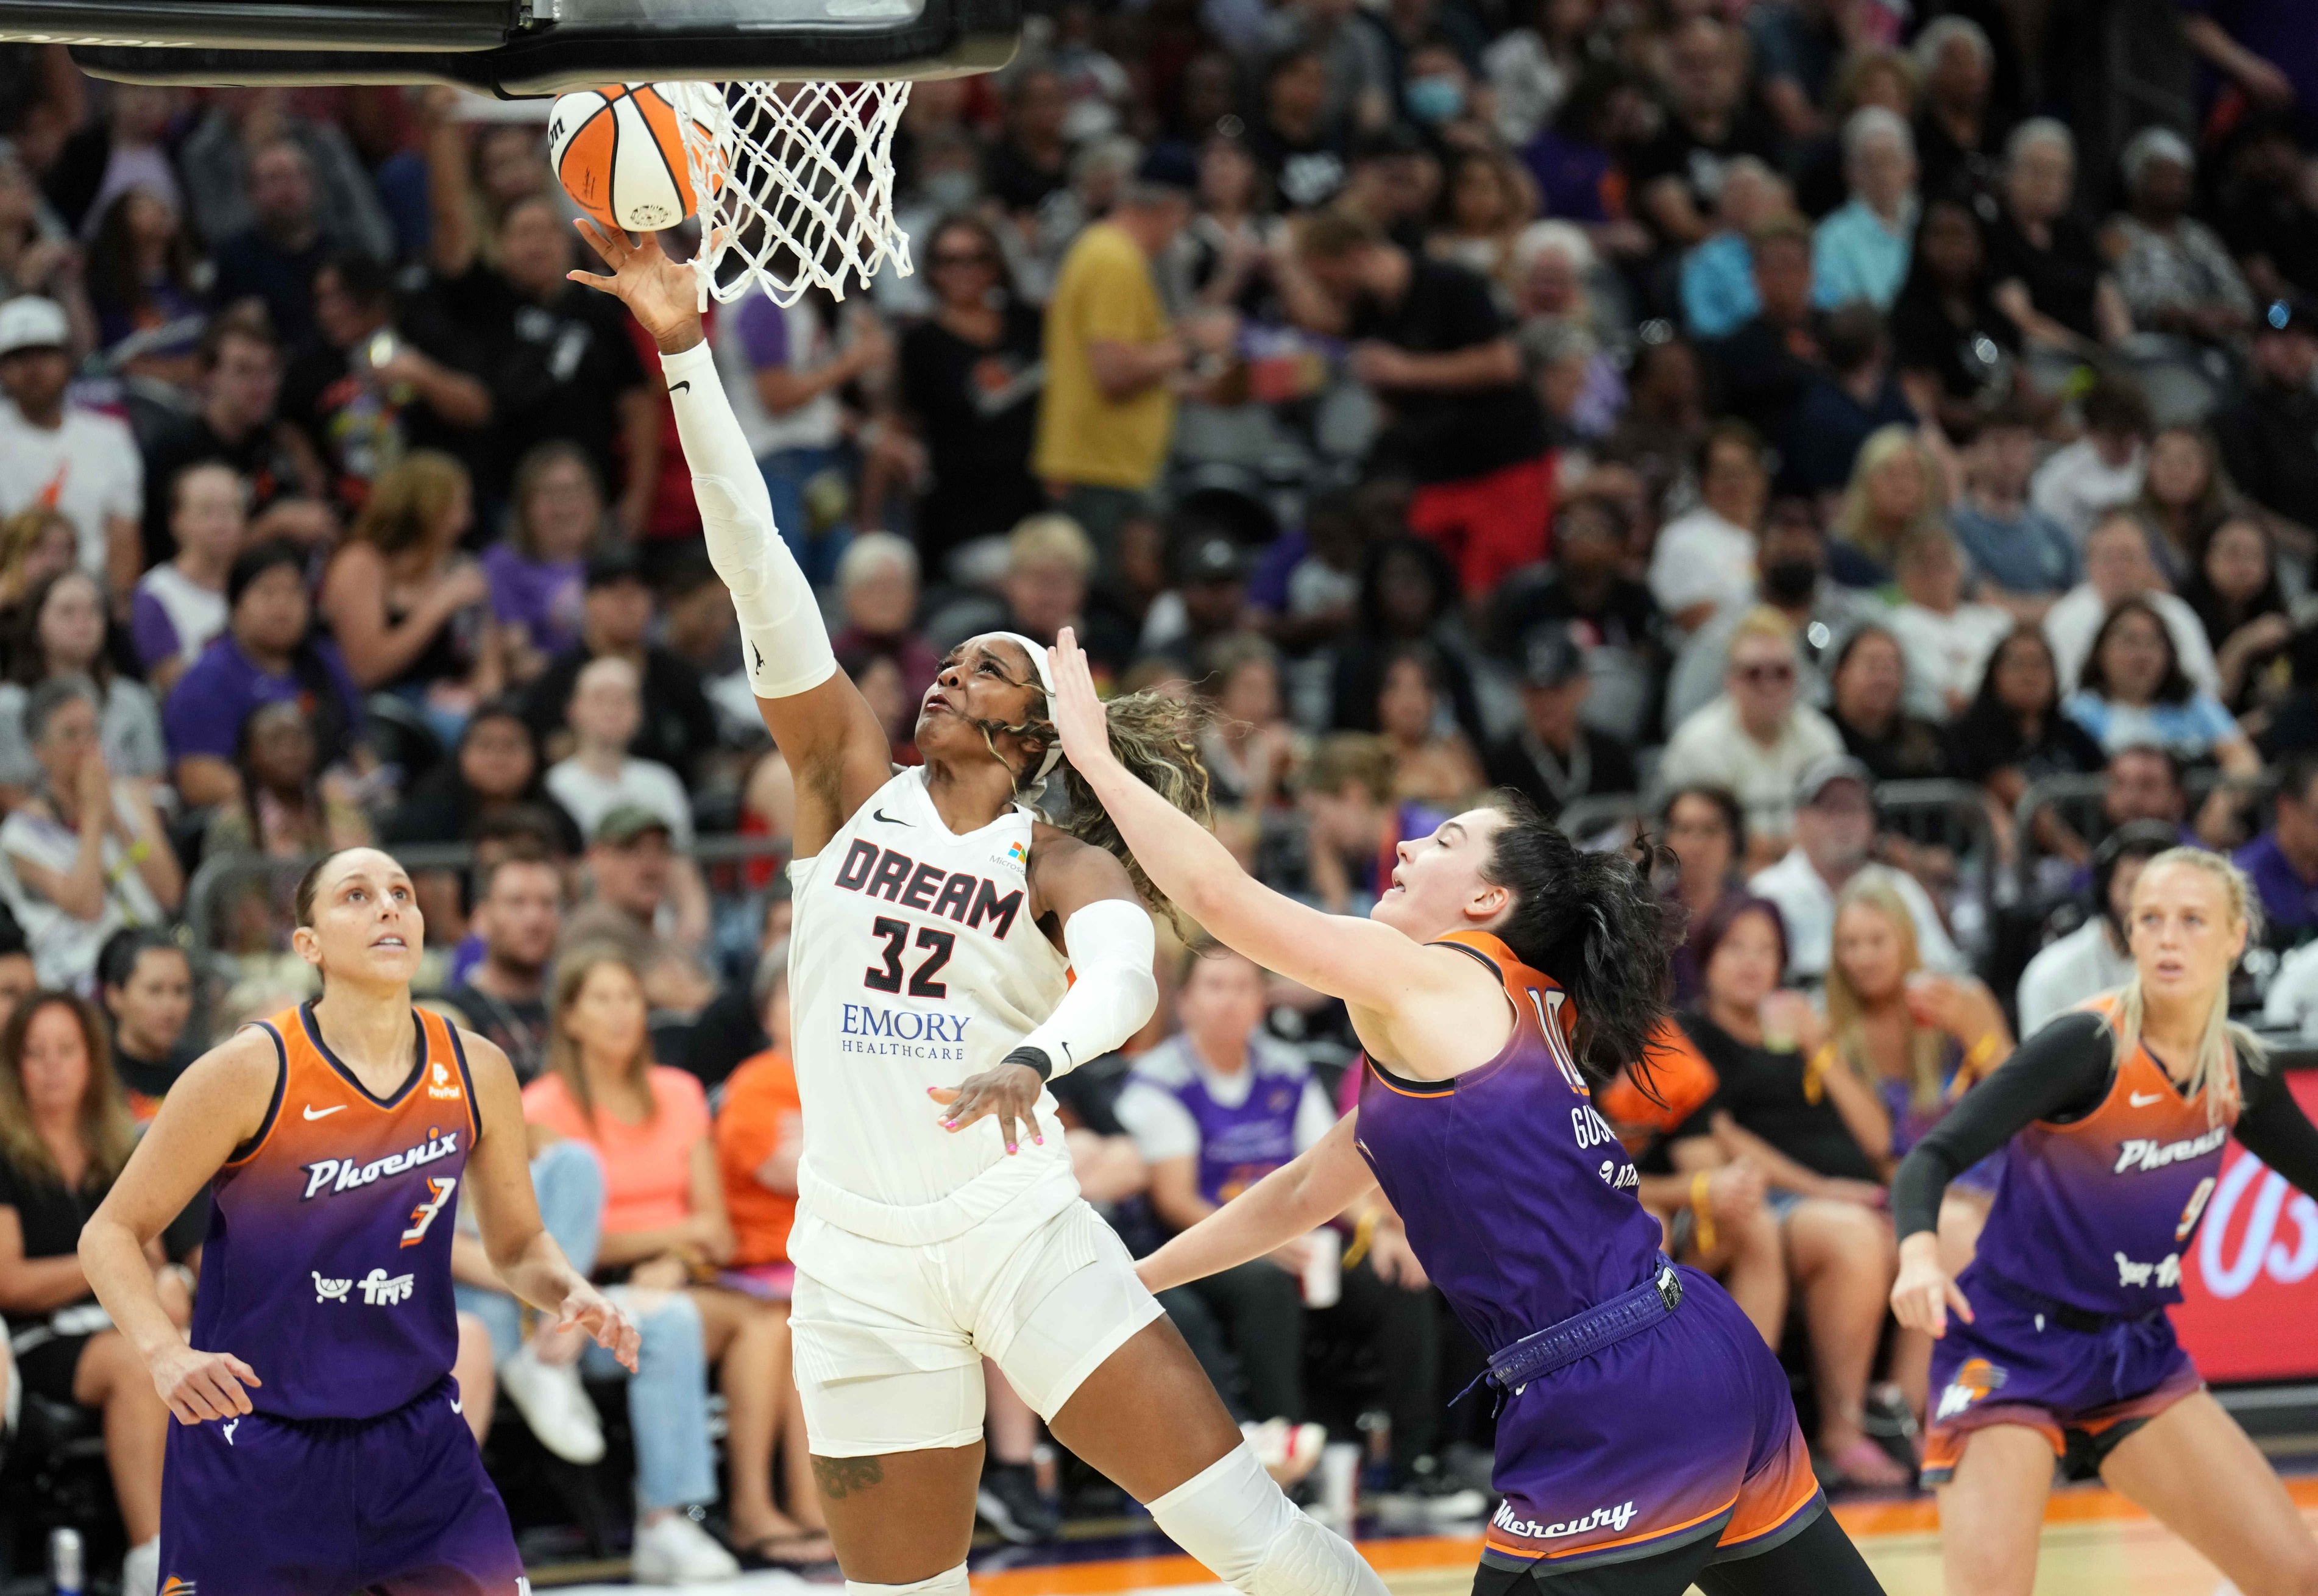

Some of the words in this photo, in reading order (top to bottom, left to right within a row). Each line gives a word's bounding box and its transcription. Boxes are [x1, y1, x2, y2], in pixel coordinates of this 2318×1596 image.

[989, 854, 1026, 877] Microso
[834, 837, 1024, 941] DREAM
[863, 915, 956, 999] 32
[840, 1002, 971, 1042] EMORY
[842, 1040, 963, 1060] HEALTHCARE
[428, 1085, 460, 1099] PayPal
[1571, 1104, 1618, 1149] GUS
[300, 1126, 460, 1202] Phoenix
[400, 1176, 456, 1249] 3
[2174, 1176, 2217, 1242] 9
[1493, 1498, 1639, 1539] Mercury
